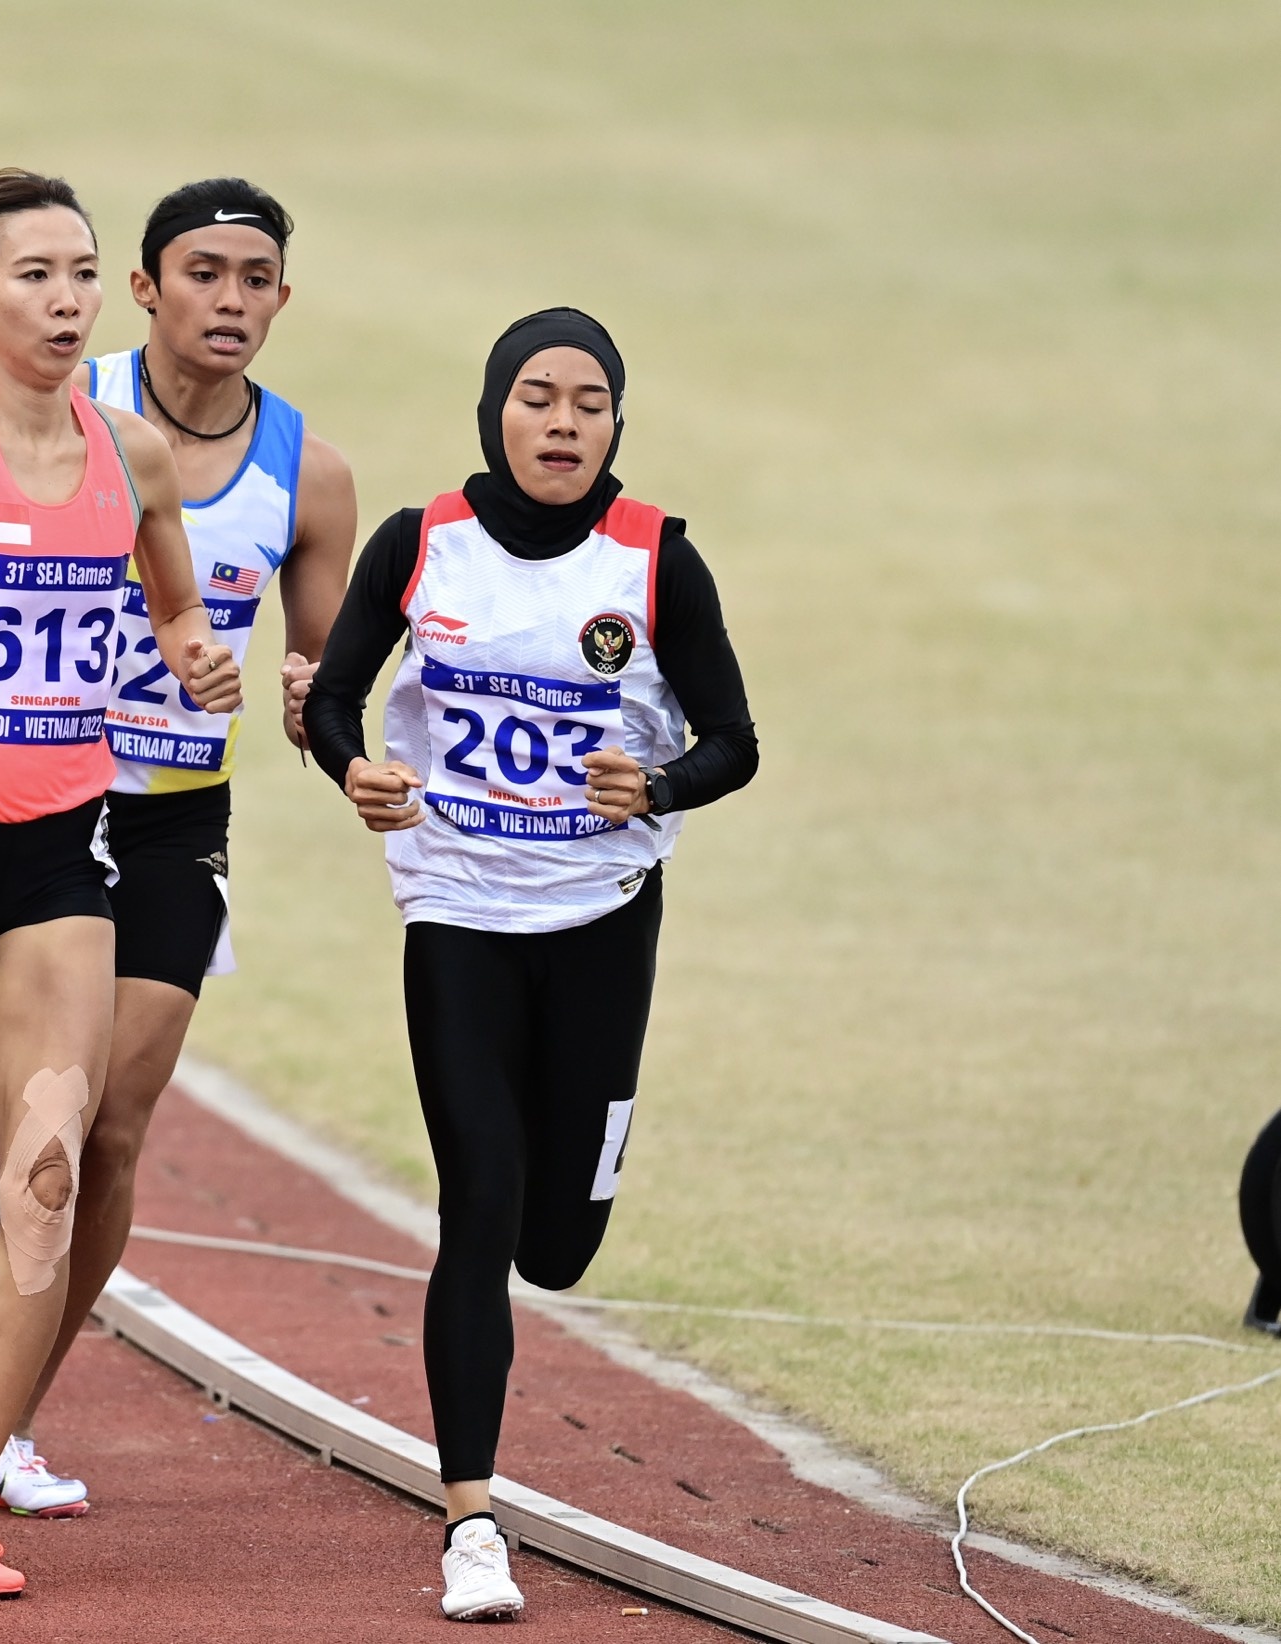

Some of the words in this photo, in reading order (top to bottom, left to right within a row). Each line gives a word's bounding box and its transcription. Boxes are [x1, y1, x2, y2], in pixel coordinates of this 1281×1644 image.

[36, 562, 63, 585] SEA
[67, 563, 113, 585] Games
[416, 627, 468, 646] LI-NING
[10, 694, 81, 708] SINGAPORE
[489, 675, 522, 697] SEA
[526, 681, 582, 707] Games
[25, 715, 79, 739] VIETNAM
[79, 714, 102, 738] 2022
[105, 709, 169, 729] MALAYSIA
[112, 730, 175, 761] VIETNAM
[176, 741, 212, 765] 2022
[442, 707, 605, 786] 203
[488, 789, 562, 807] INDONESIA
[438, 800, 485, 828] HANOI
[499, 812, 570, 835] VIETNAM
